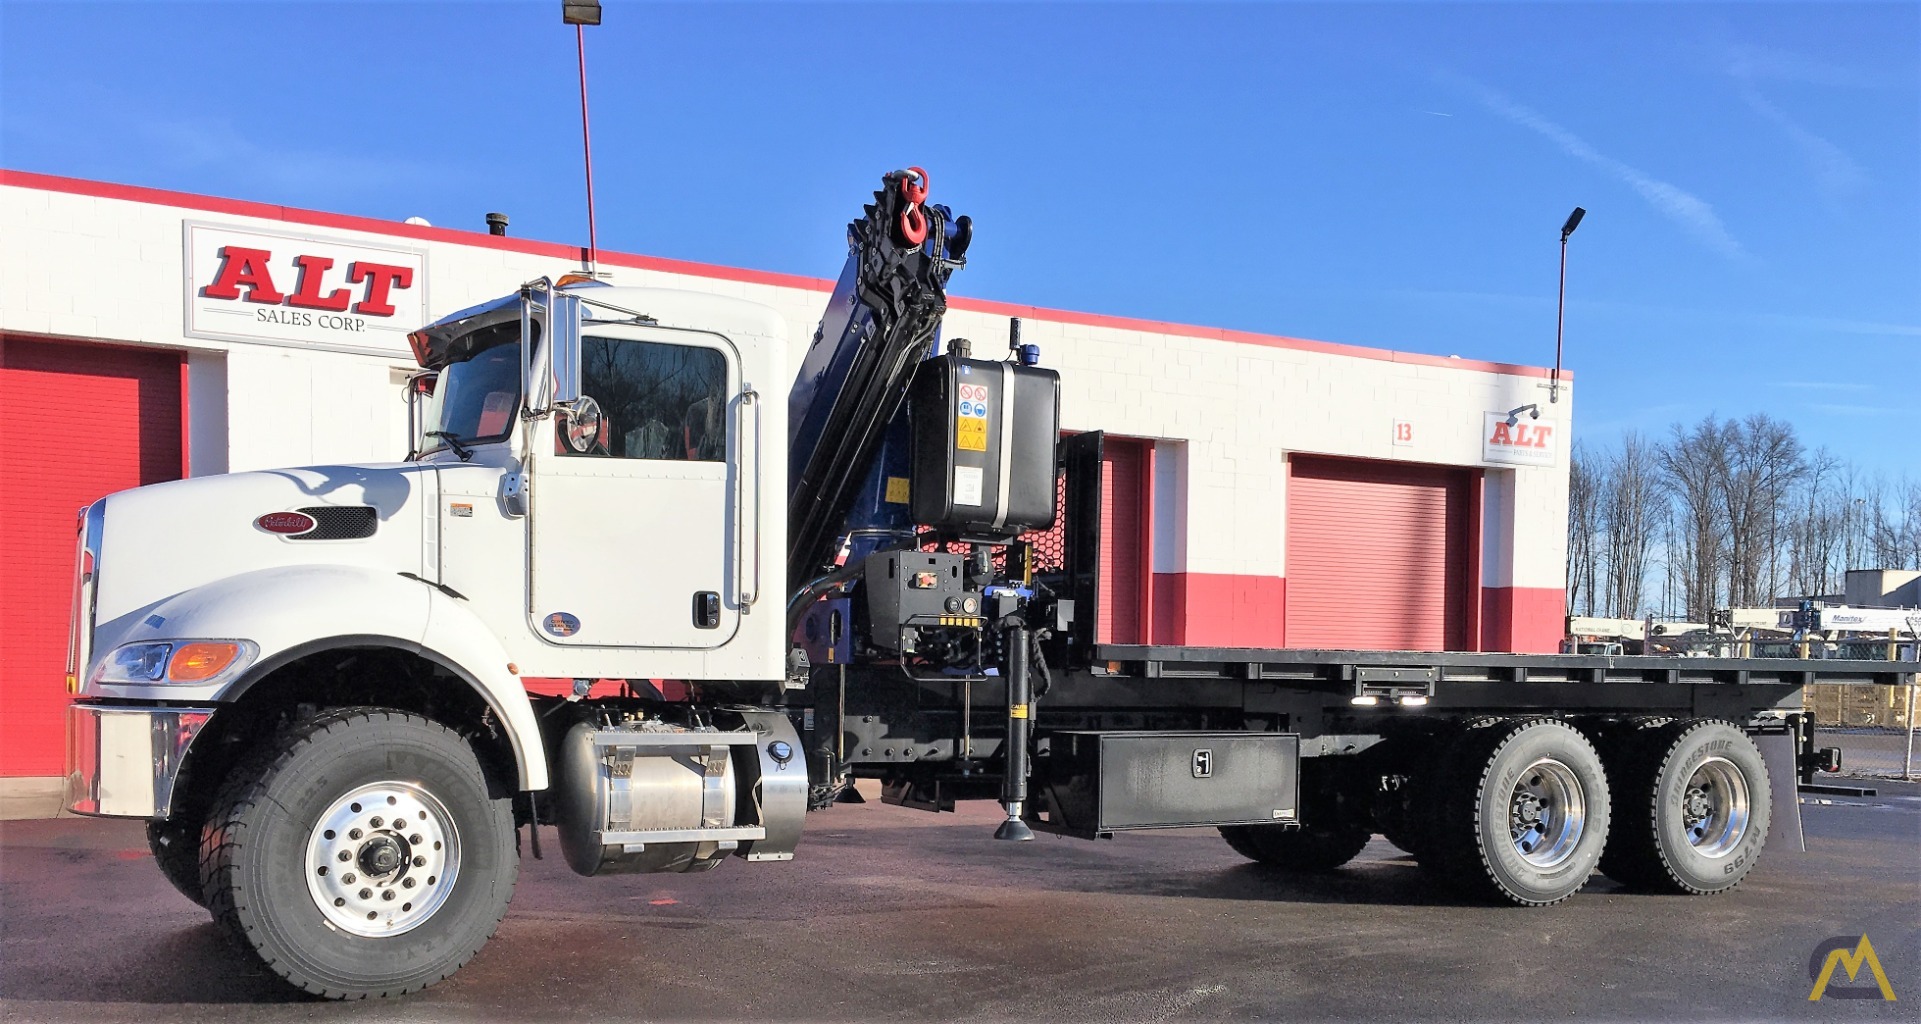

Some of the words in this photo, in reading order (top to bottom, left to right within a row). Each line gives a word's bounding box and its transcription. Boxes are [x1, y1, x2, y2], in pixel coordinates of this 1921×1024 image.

[202, 245, 413, 317] ALT
[257, 308, 312, 327] SALES
[318, 315, 366, 333] CORP.
[1396, 423, 1412, 442] 13
[1489, 421, 1552, 448] ALT
[264, 515, 309, 531] Peterbilt
[1832, 614, 1863, 623] Manitex
[1671, 739, 1733, 808] BRIDGESTONE
[299, 776, 328, 806] 22.5
